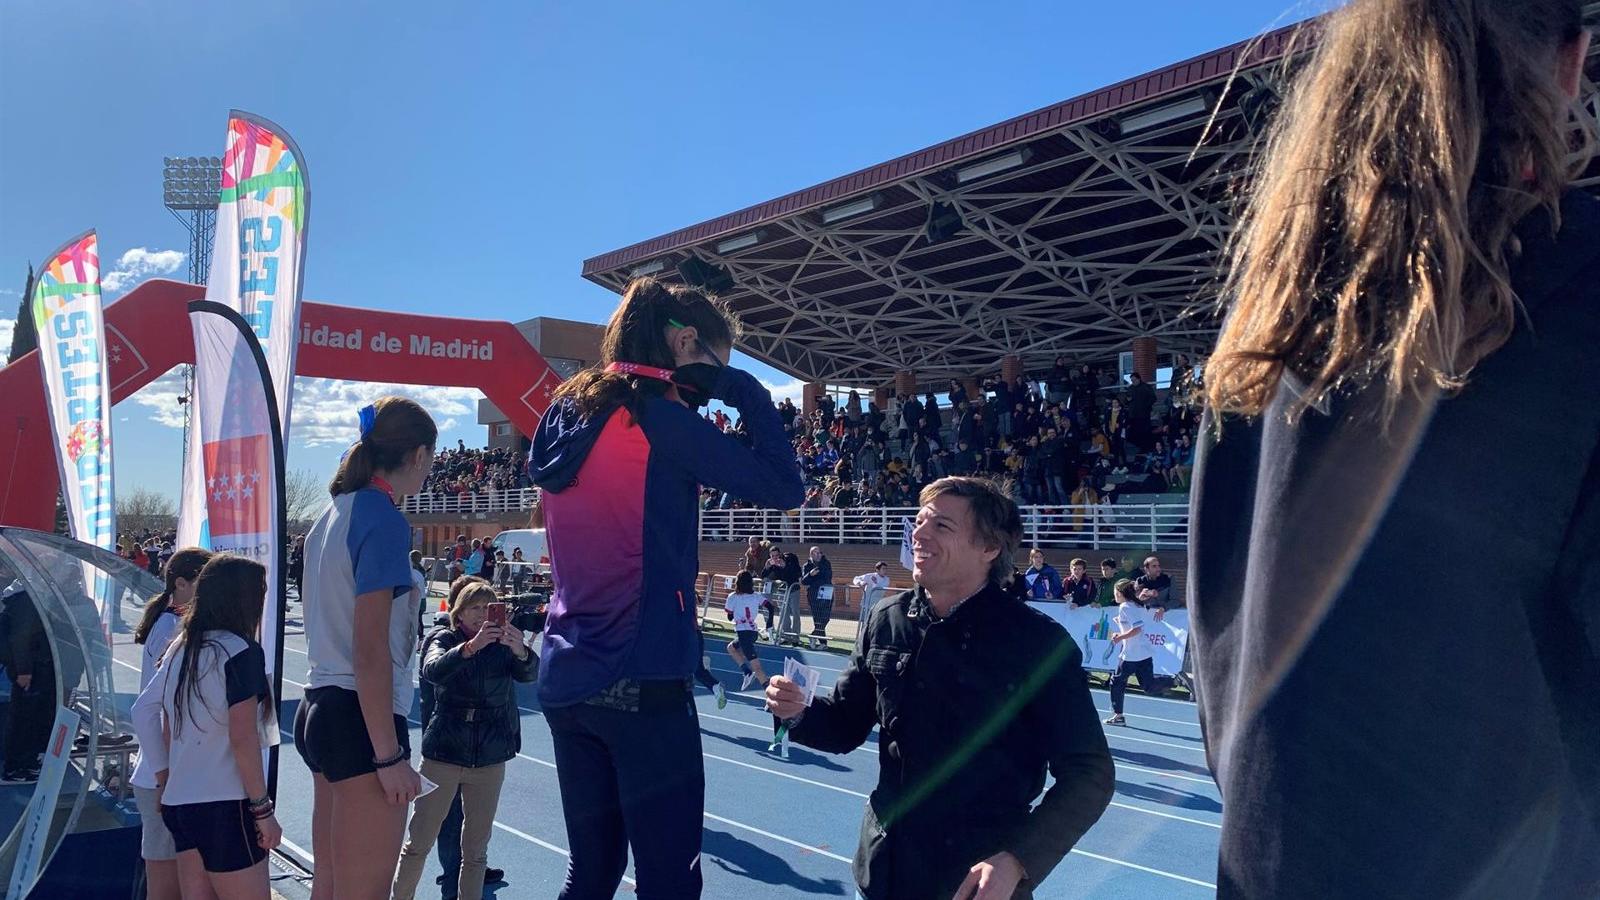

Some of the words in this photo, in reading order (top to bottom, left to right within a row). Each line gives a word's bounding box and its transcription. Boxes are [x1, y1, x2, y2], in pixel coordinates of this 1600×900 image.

[298, 322, 362, 350] idad
[370, 331, 402, 354] de
[409, 334, 493, 360] Madrid
